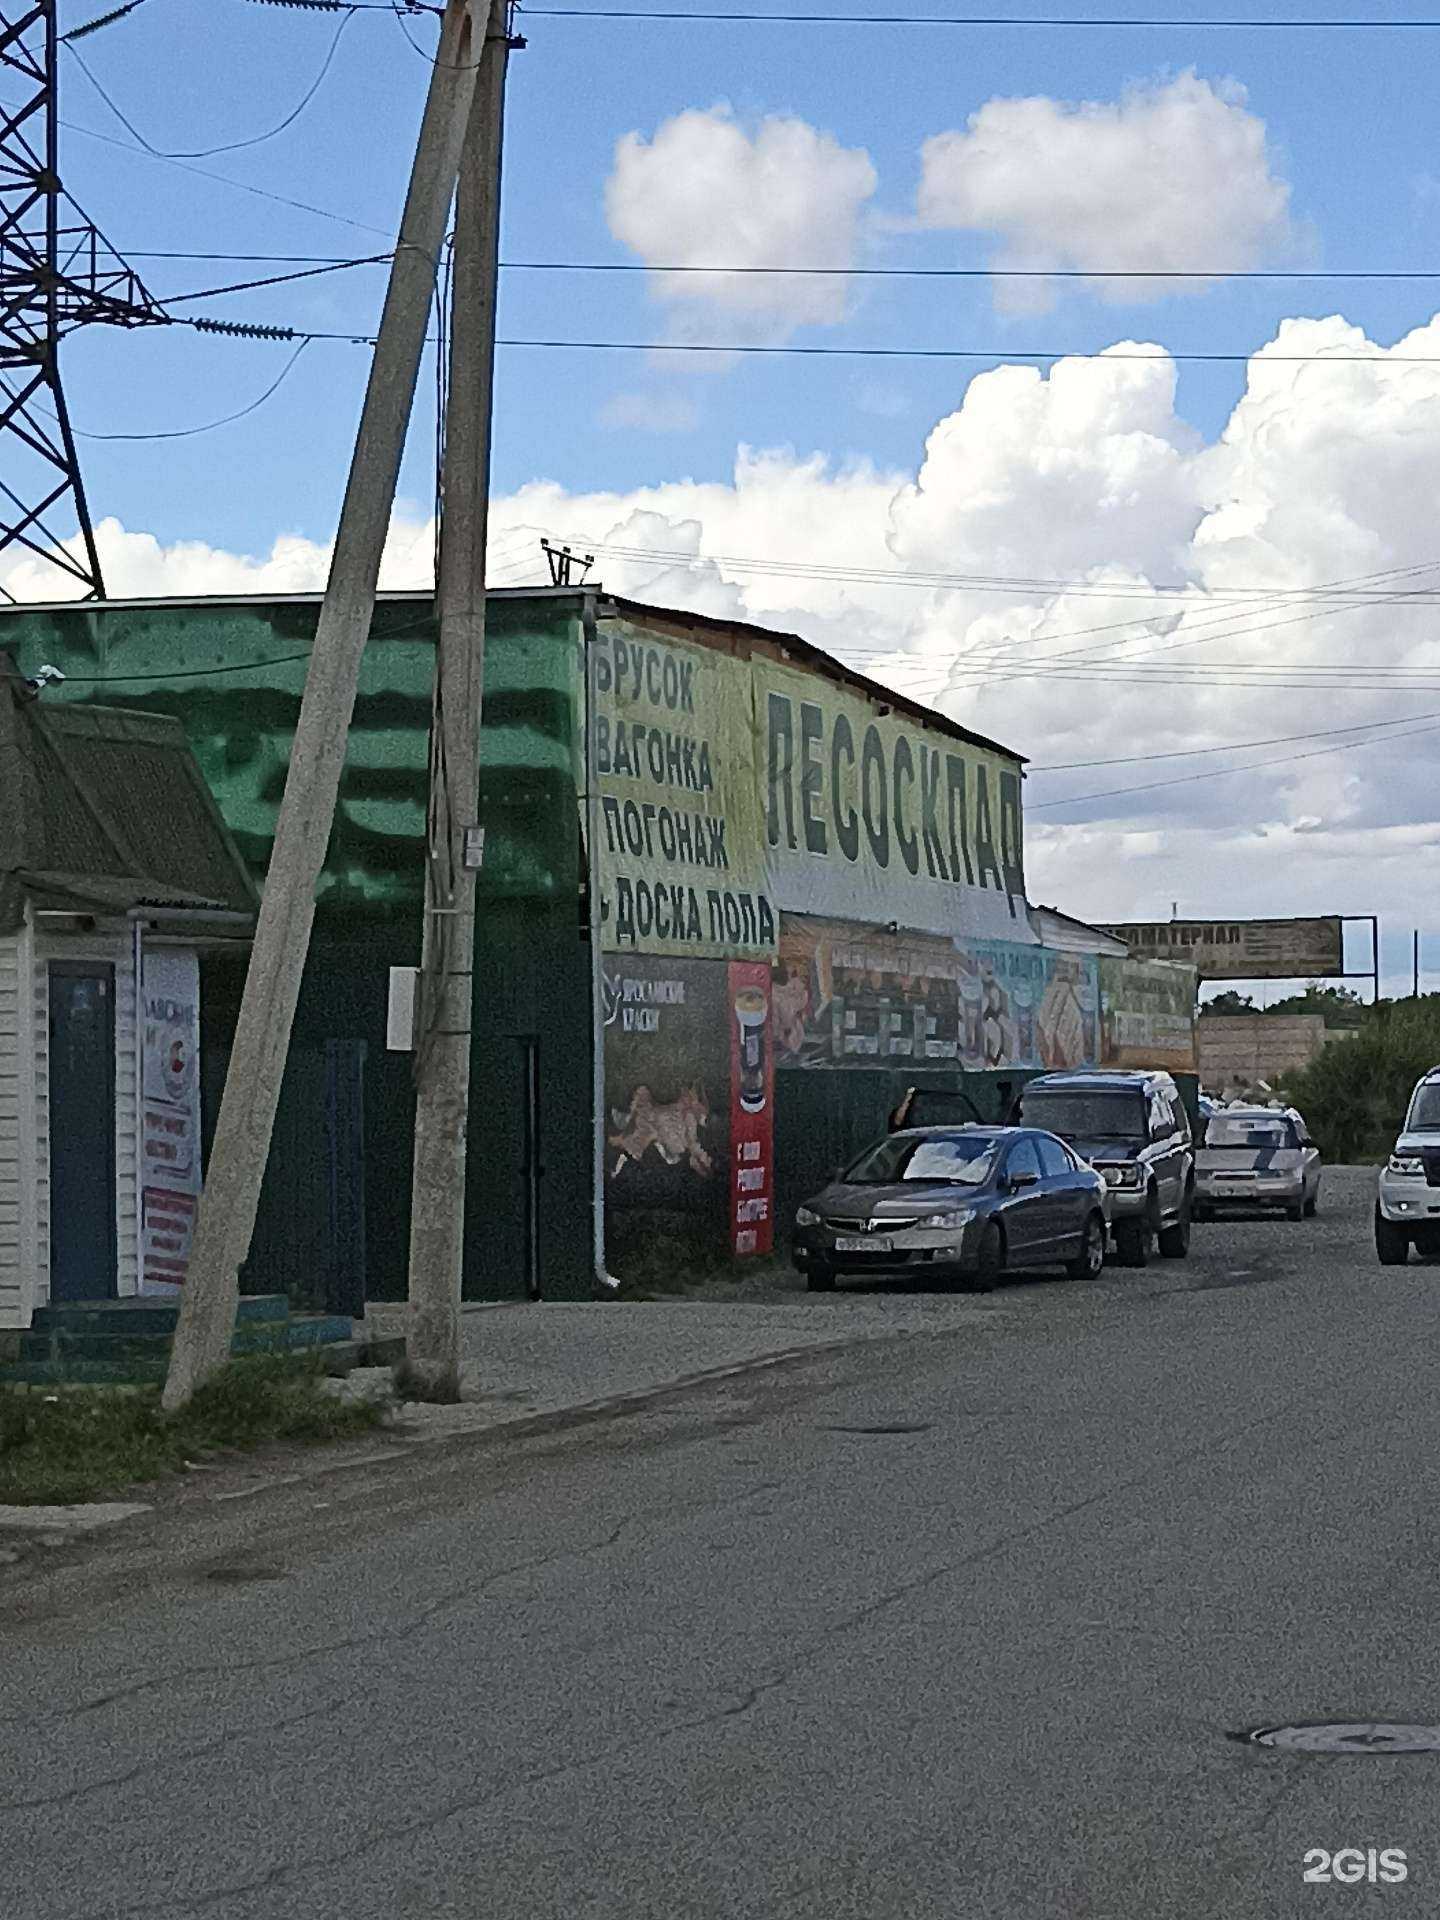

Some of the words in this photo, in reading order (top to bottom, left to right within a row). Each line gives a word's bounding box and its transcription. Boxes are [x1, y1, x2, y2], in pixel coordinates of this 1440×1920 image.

[590, 634, 694, 714] БРУСОК
[595, 716, 713, 792] ВАГОНКА
[602, 797, 729, 870] ПОГОНАЖ
[768, 692, 1026, 919] ЛЕСОСКЛАД
[616, 877, 702, 946] ДОСКА
